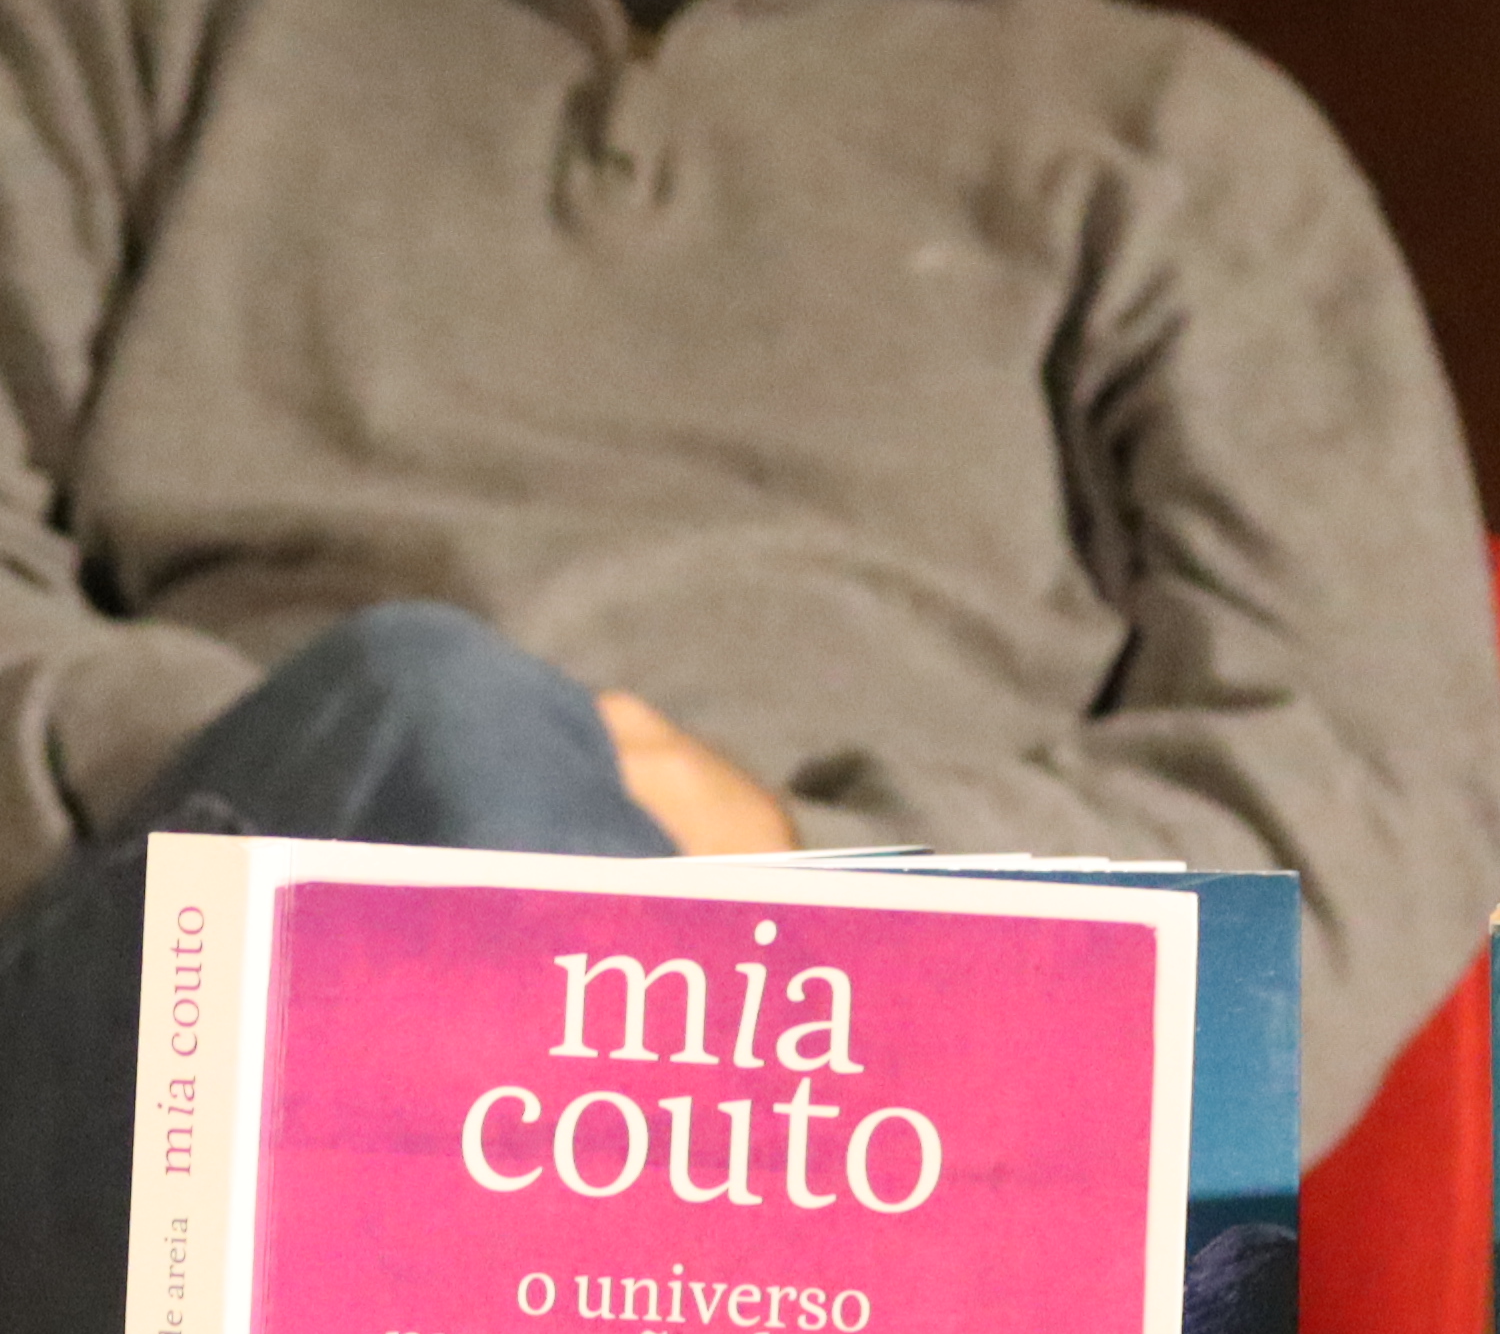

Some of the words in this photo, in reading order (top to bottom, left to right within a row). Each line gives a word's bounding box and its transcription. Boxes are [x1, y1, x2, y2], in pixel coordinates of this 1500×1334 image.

[168, 905, 206, 1057] couto
[549, 919, 864, 1075] mia
[157, 1073, 197, 1177] mia
[461, 1078, 942, 1214] couto
[164, 1217, 189, 1300] areia
[517, 1272, 555, 1316] o
[575, 1263, 871, 1334] universo
